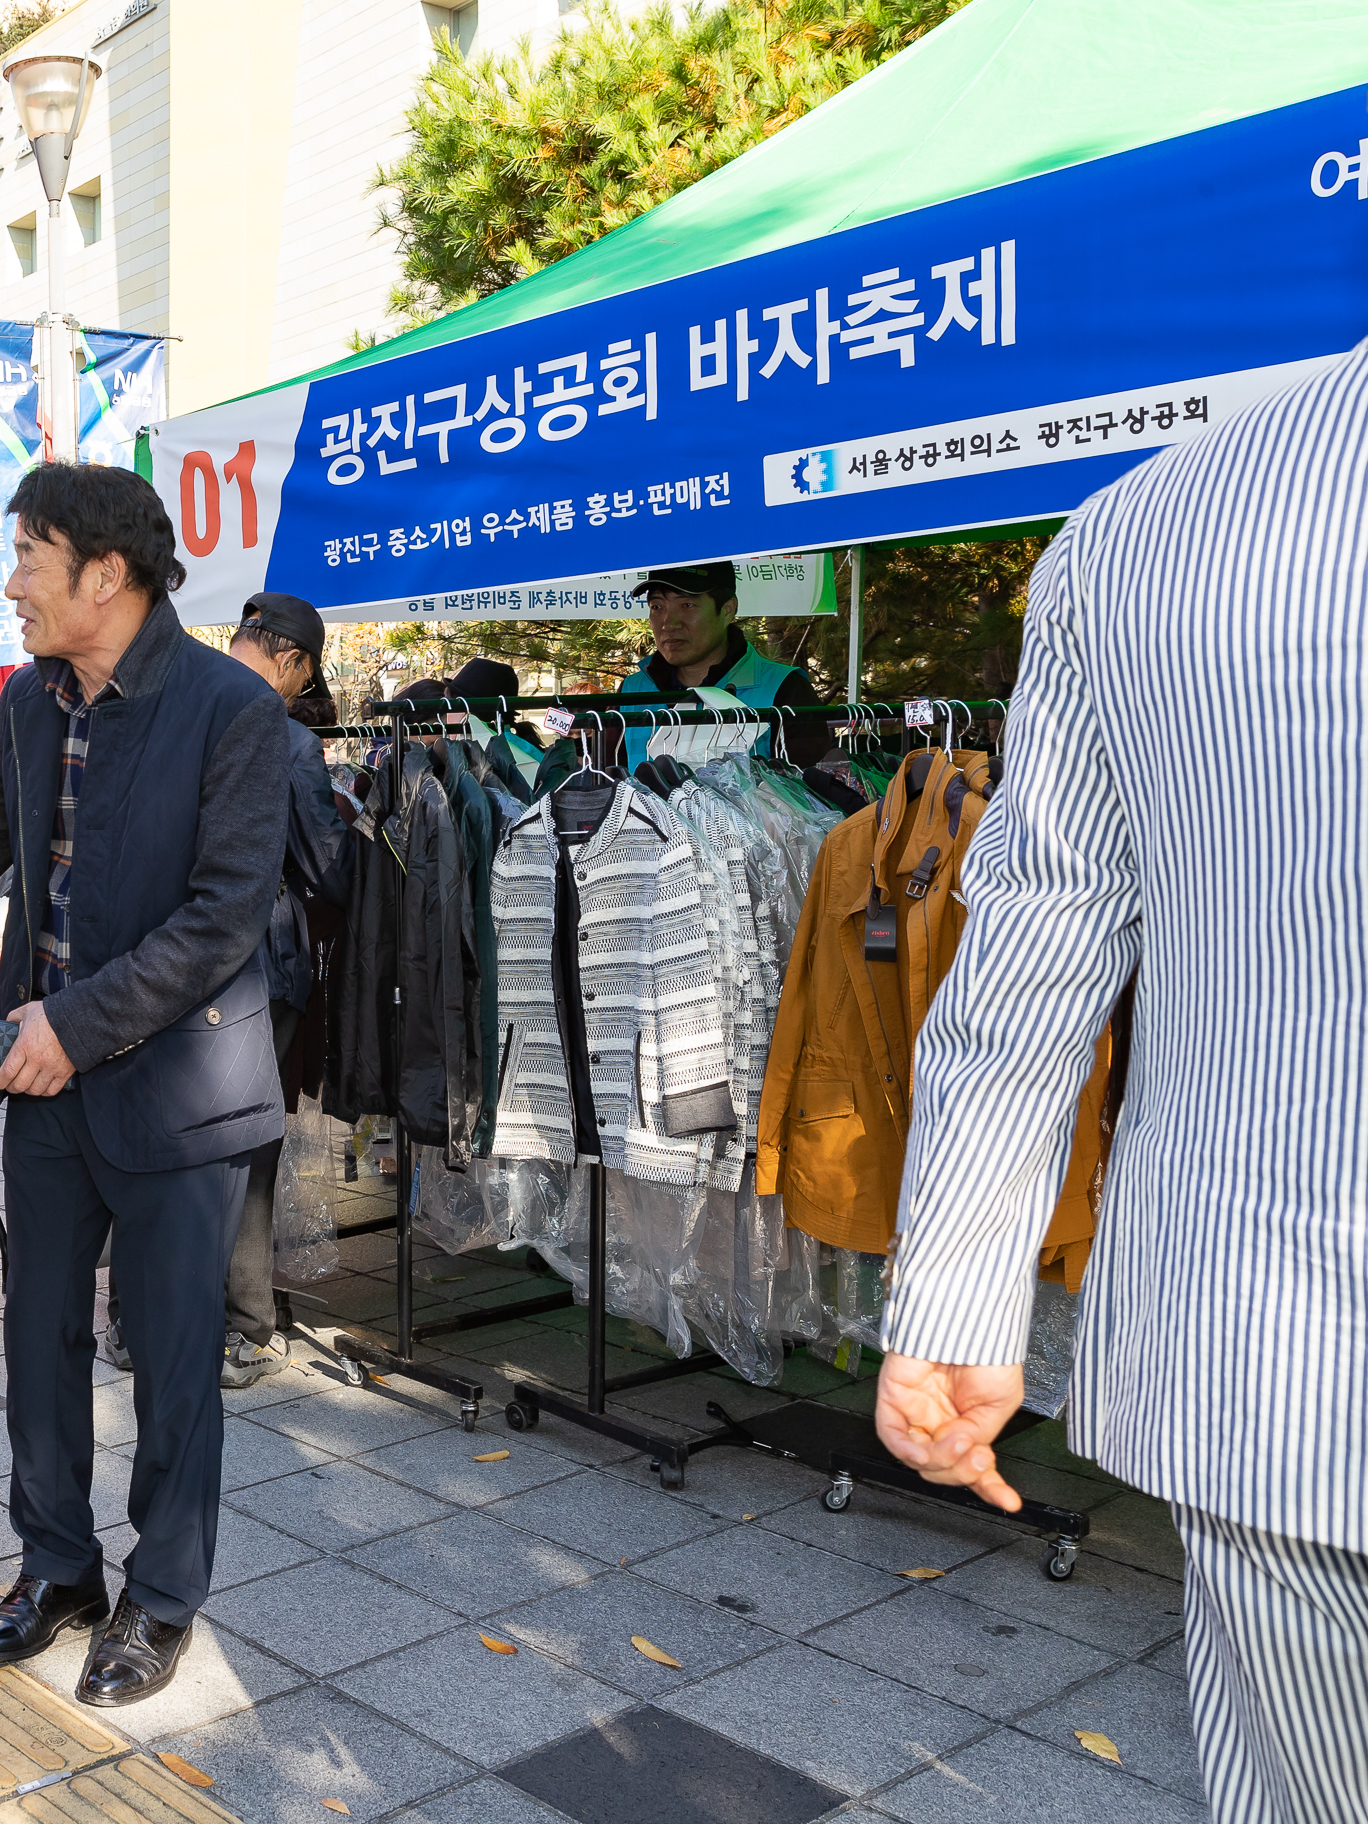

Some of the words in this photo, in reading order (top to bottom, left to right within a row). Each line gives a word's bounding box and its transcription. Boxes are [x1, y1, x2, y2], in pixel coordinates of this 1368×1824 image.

[113, 368, 153, 395] NH
[320, 331, 658, 486] 광진구상공회
[689, 239, 1016, 402] 바자축제
[848, 429, 1021, 478] 서울상공회의소
[1037, 395, 1209, 448] 광진구상공회
[179, 439, 258, 558] 01
[323, 533, 381, 567] 광진구
[387, 516, 472, 557] 중소기업
[480, 498, 576, 543] 우수제품
